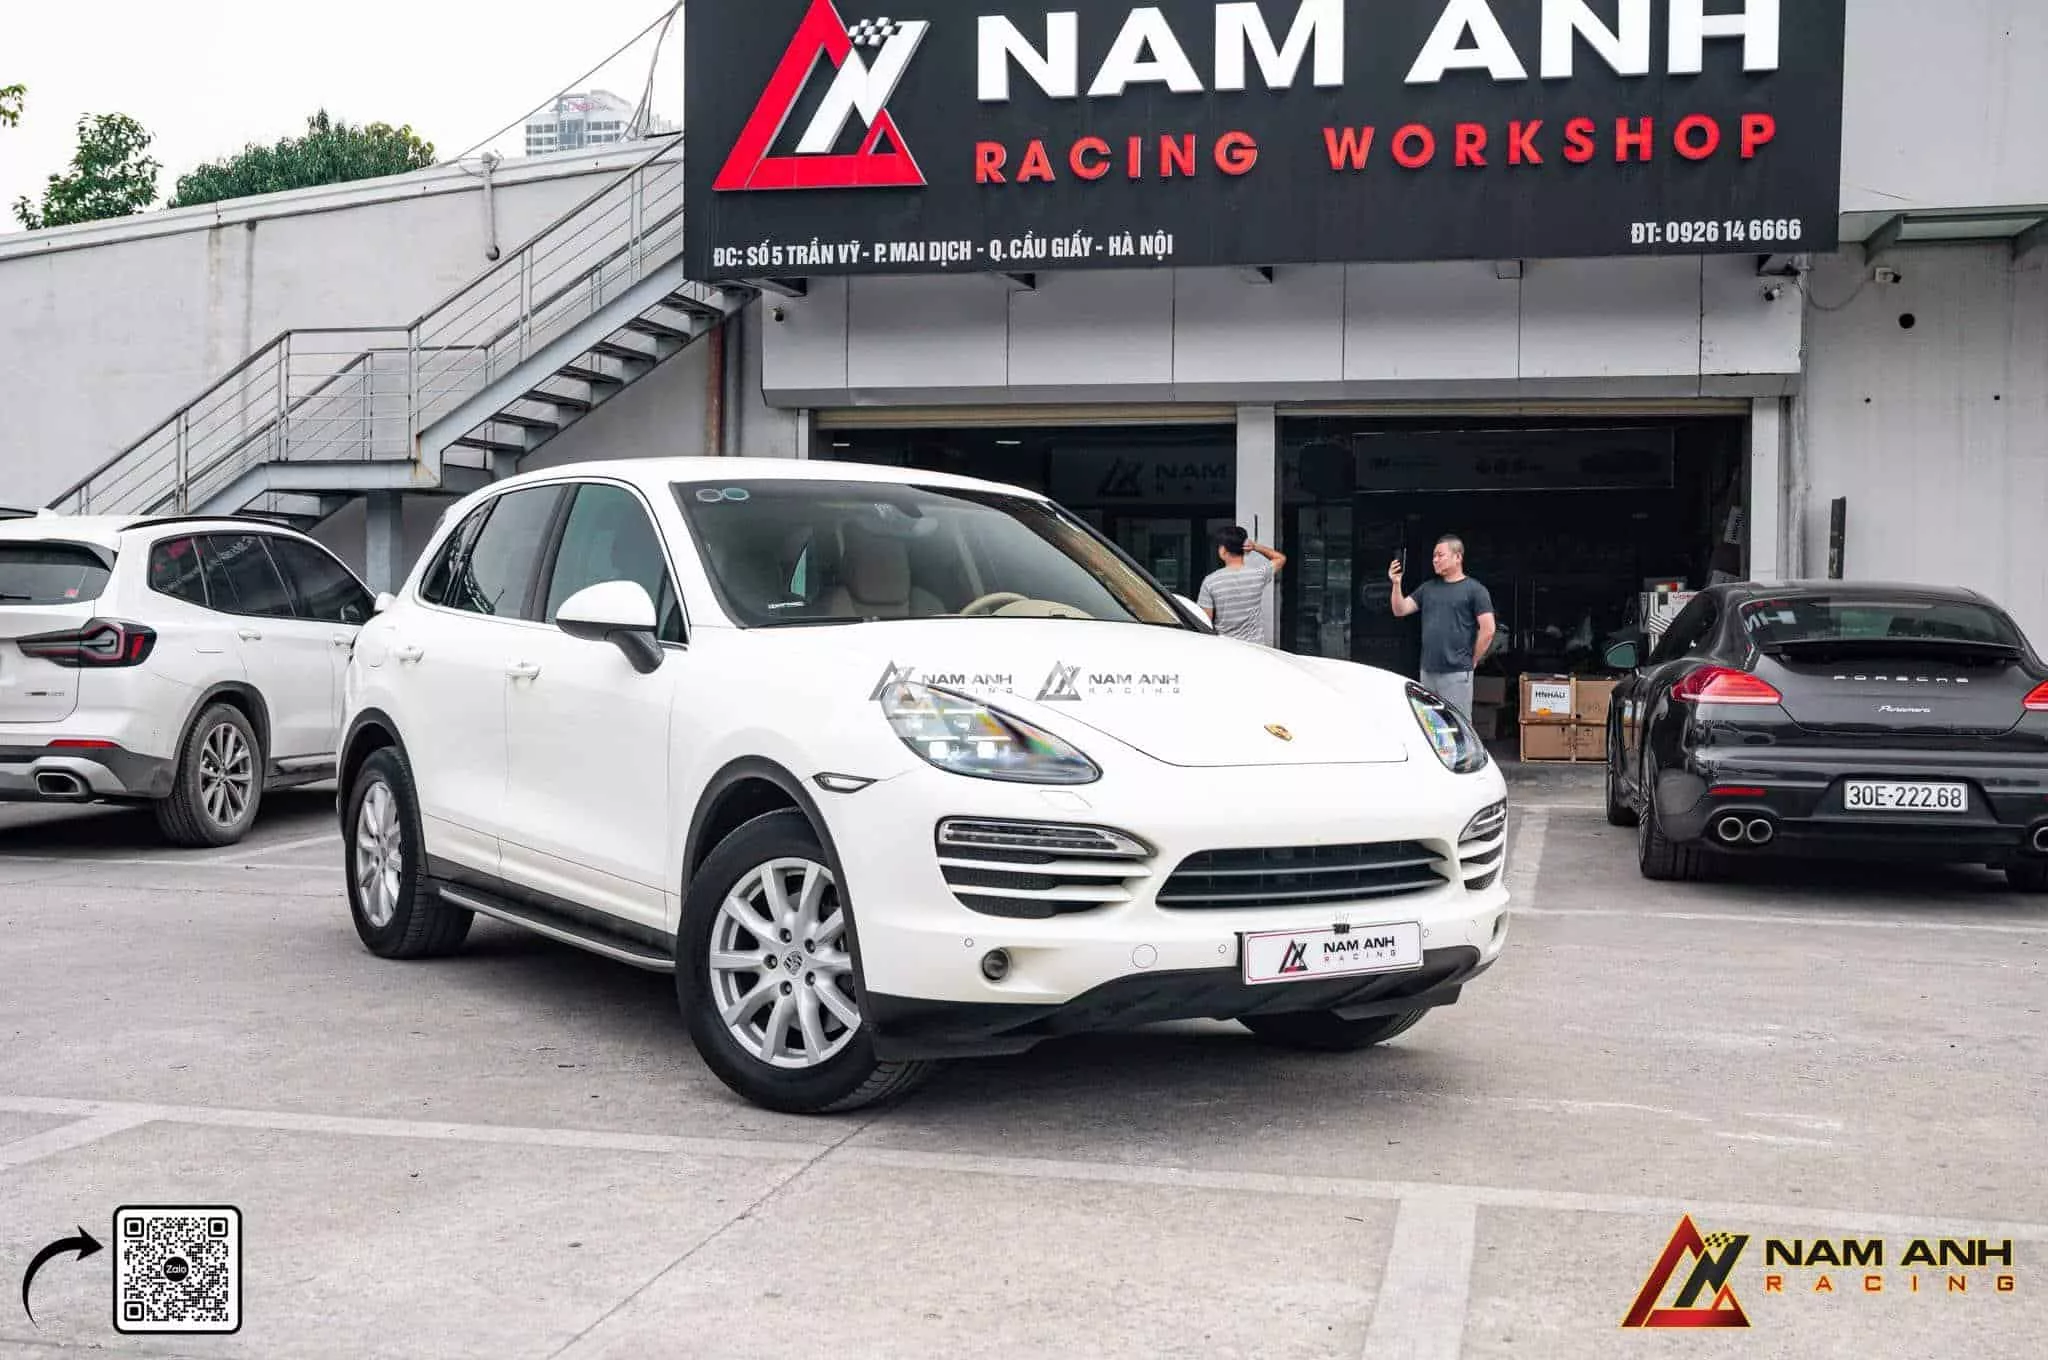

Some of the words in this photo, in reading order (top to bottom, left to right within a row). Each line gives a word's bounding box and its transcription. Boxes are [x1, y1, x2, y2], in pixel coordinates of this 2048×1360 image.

[977, 0, 1345, 101] NAM
[1404, 0, 1780, 84] ANH
[975, 130, 1258, 184] RACING
[1323, 112, 1777, 170] WORKSHOP
[1631, 222, 1662, 244] ĐT:
[1665, 221, 1719, 243] 0926
[1723, 220, 1746, 241] 14
[1749, 219, 1802, 241] 6666
[713, 246, 743, 267] ĐC:
[746, 239, 770, 266] SỐ
[771, 245, 783, 266] 5
[786, 236, 834, 265] TRẦN
[838, 239, 861, 264] VỸ
[929, 239, 972, 267] DỊCH
[1051, 229, 1093, 258] GIẤY
[1108, 230, 1135, 257] HÀ
[1139, 229, 1174, 261] NỘI
[1155, 462, 1227, 481] NAM
[1849, 785, 1962, 809] 30E-222.68
[1324, 940, 1359, 954] NAM
[1363, 935, 1395, 950] ANH
